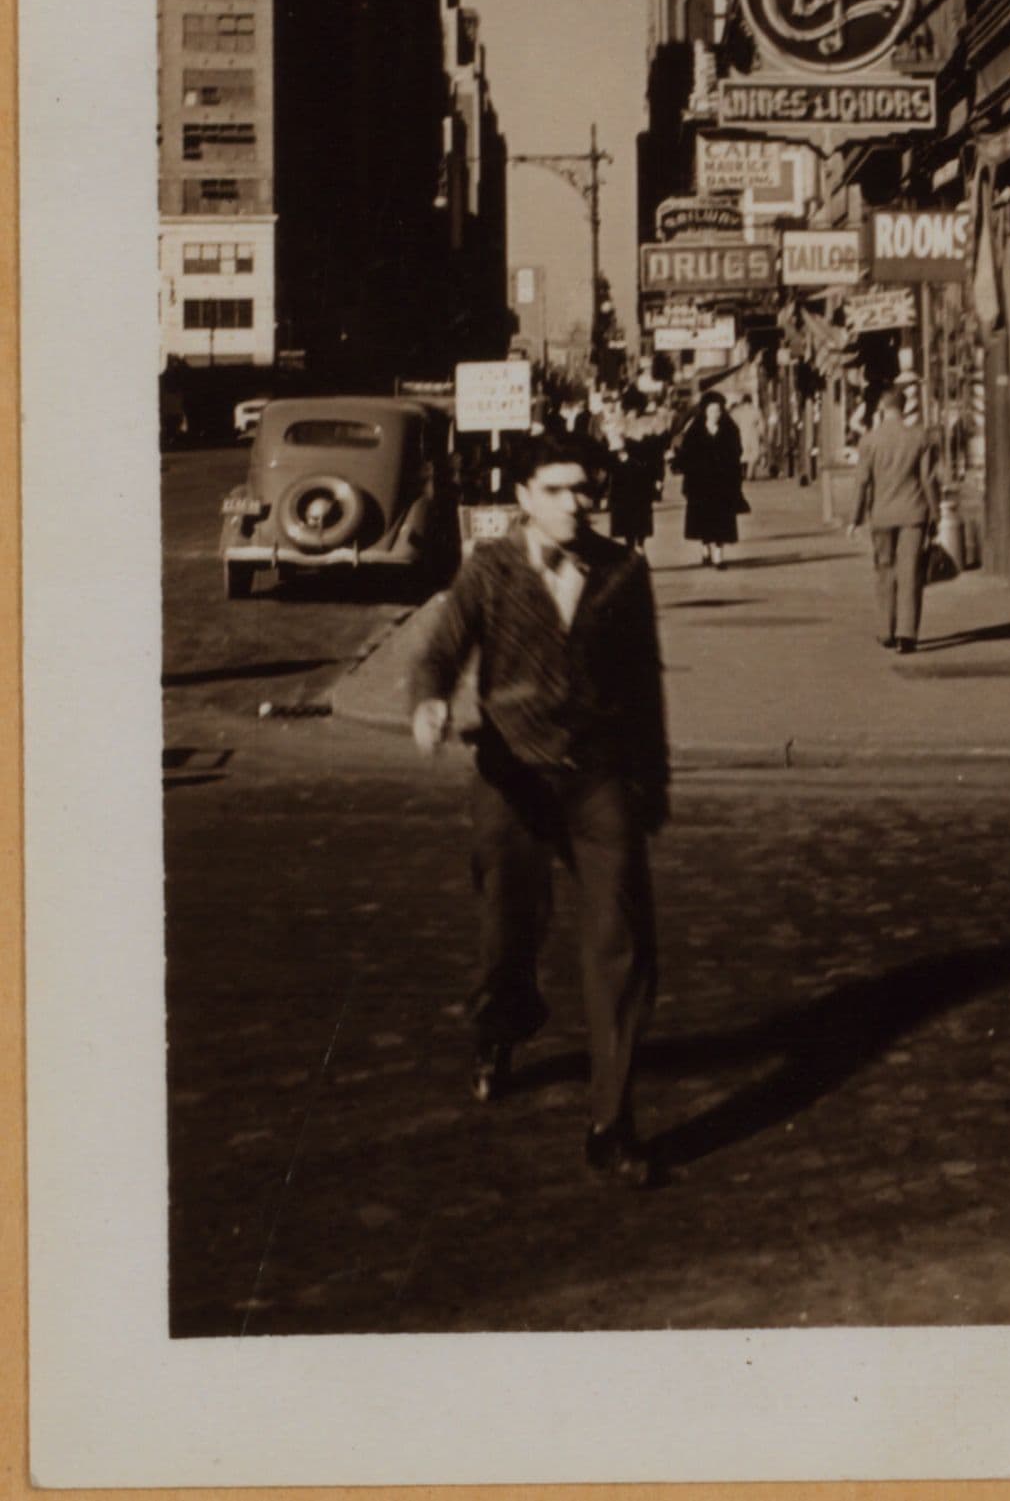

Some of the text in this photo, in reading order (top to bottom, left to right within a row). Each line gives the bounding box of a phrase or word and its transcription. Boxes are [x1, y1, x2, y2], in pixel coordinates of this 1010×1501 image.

[813, 86, 929, 122] LIQUORS
[874, 213, 970, 260] ROOMS
[648, 248, 769, 282] DRUGS
[786, 244, 857, 273] TAILOR
